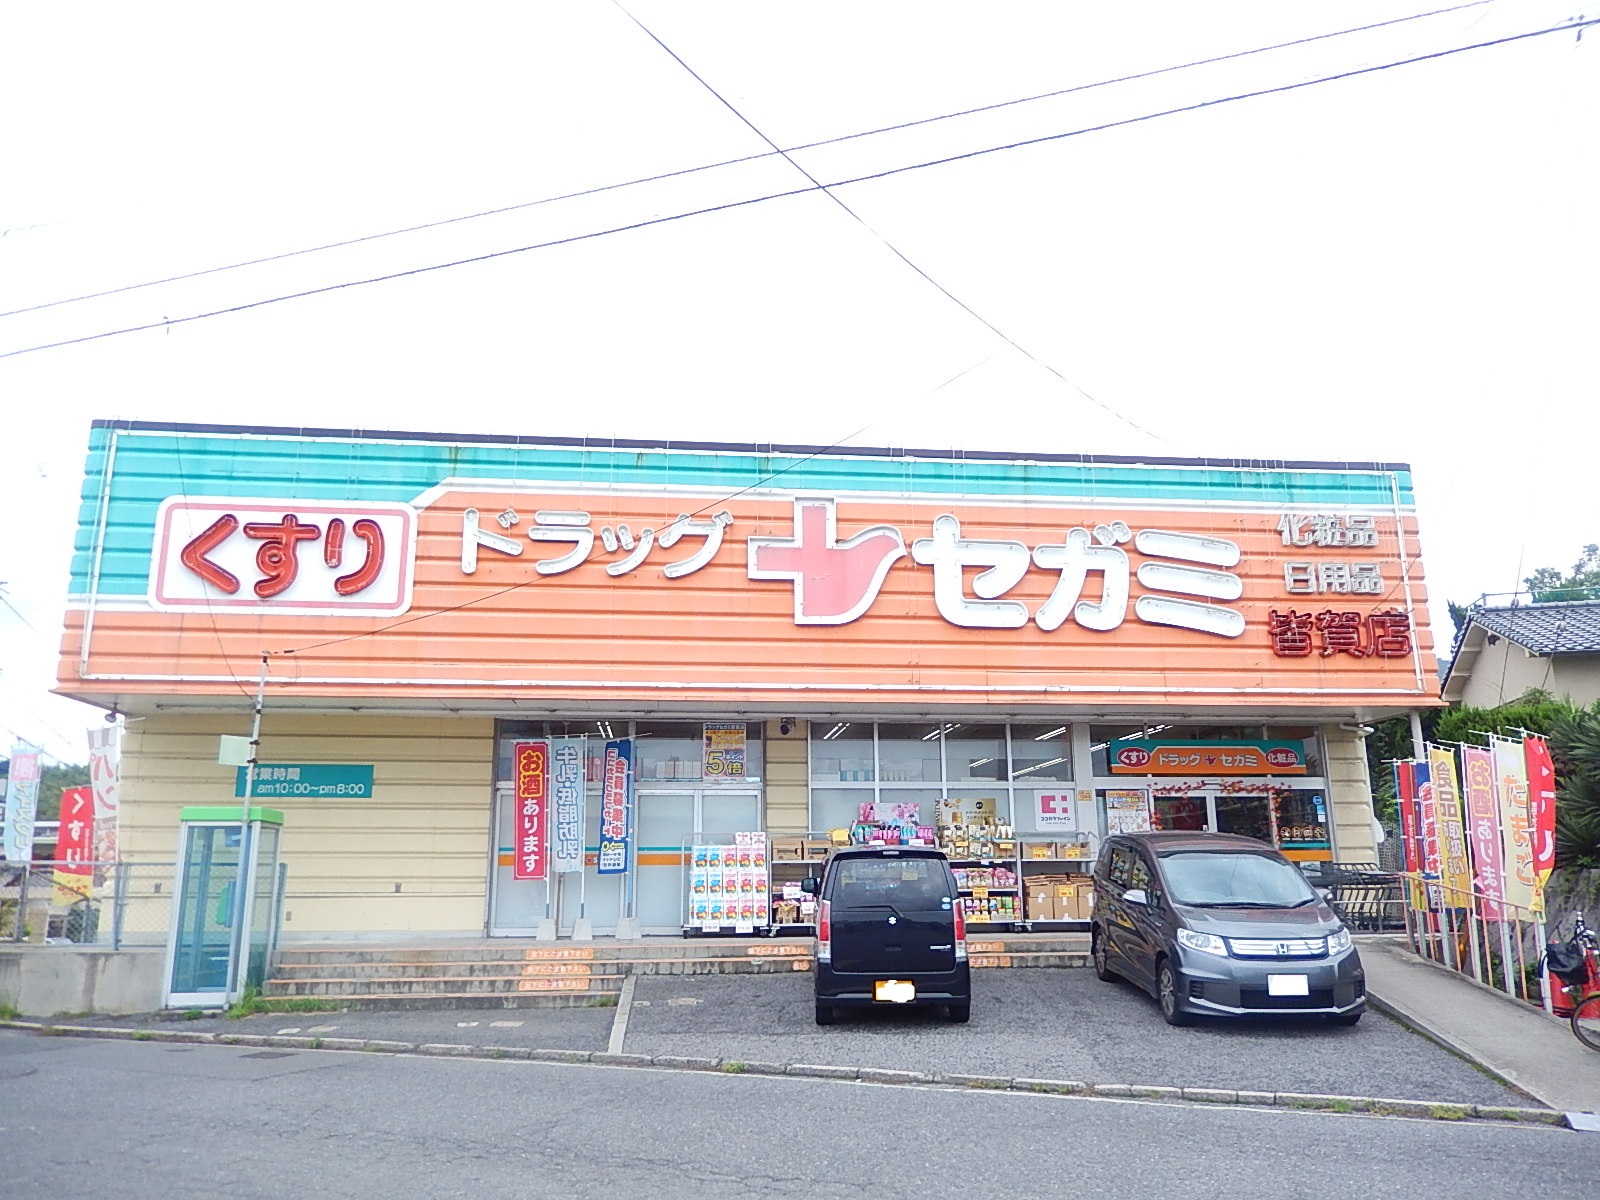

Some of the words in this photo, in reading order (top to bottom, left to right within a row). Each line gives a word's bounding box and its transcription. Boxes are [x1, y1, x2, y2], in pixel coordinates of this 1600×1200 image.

[1277, 513, 1379, 547] 化粧品
[180, 512, 386, 598] くすり
[462, 506, 734, 578] ドラッグ
[911, 512, 1247, 638] セガミ
[1284, 561, 1385, 594] 日用品
[1268, 609, 1411, 658] 皆賀店
[705, 750, 724, 774] 5
[726, 760, 744, 774] 倍
[1120, 751, 1149, 764] くすり
[1158, 752, 1201, 767] ドラッグ
[1220, 753, 1258, 767] セガミ
[1267, 752, 1297, 764] 化粧品
[245, 767, 300, 781] 営業時間
[519, 749, 544, 873] お酒あります
